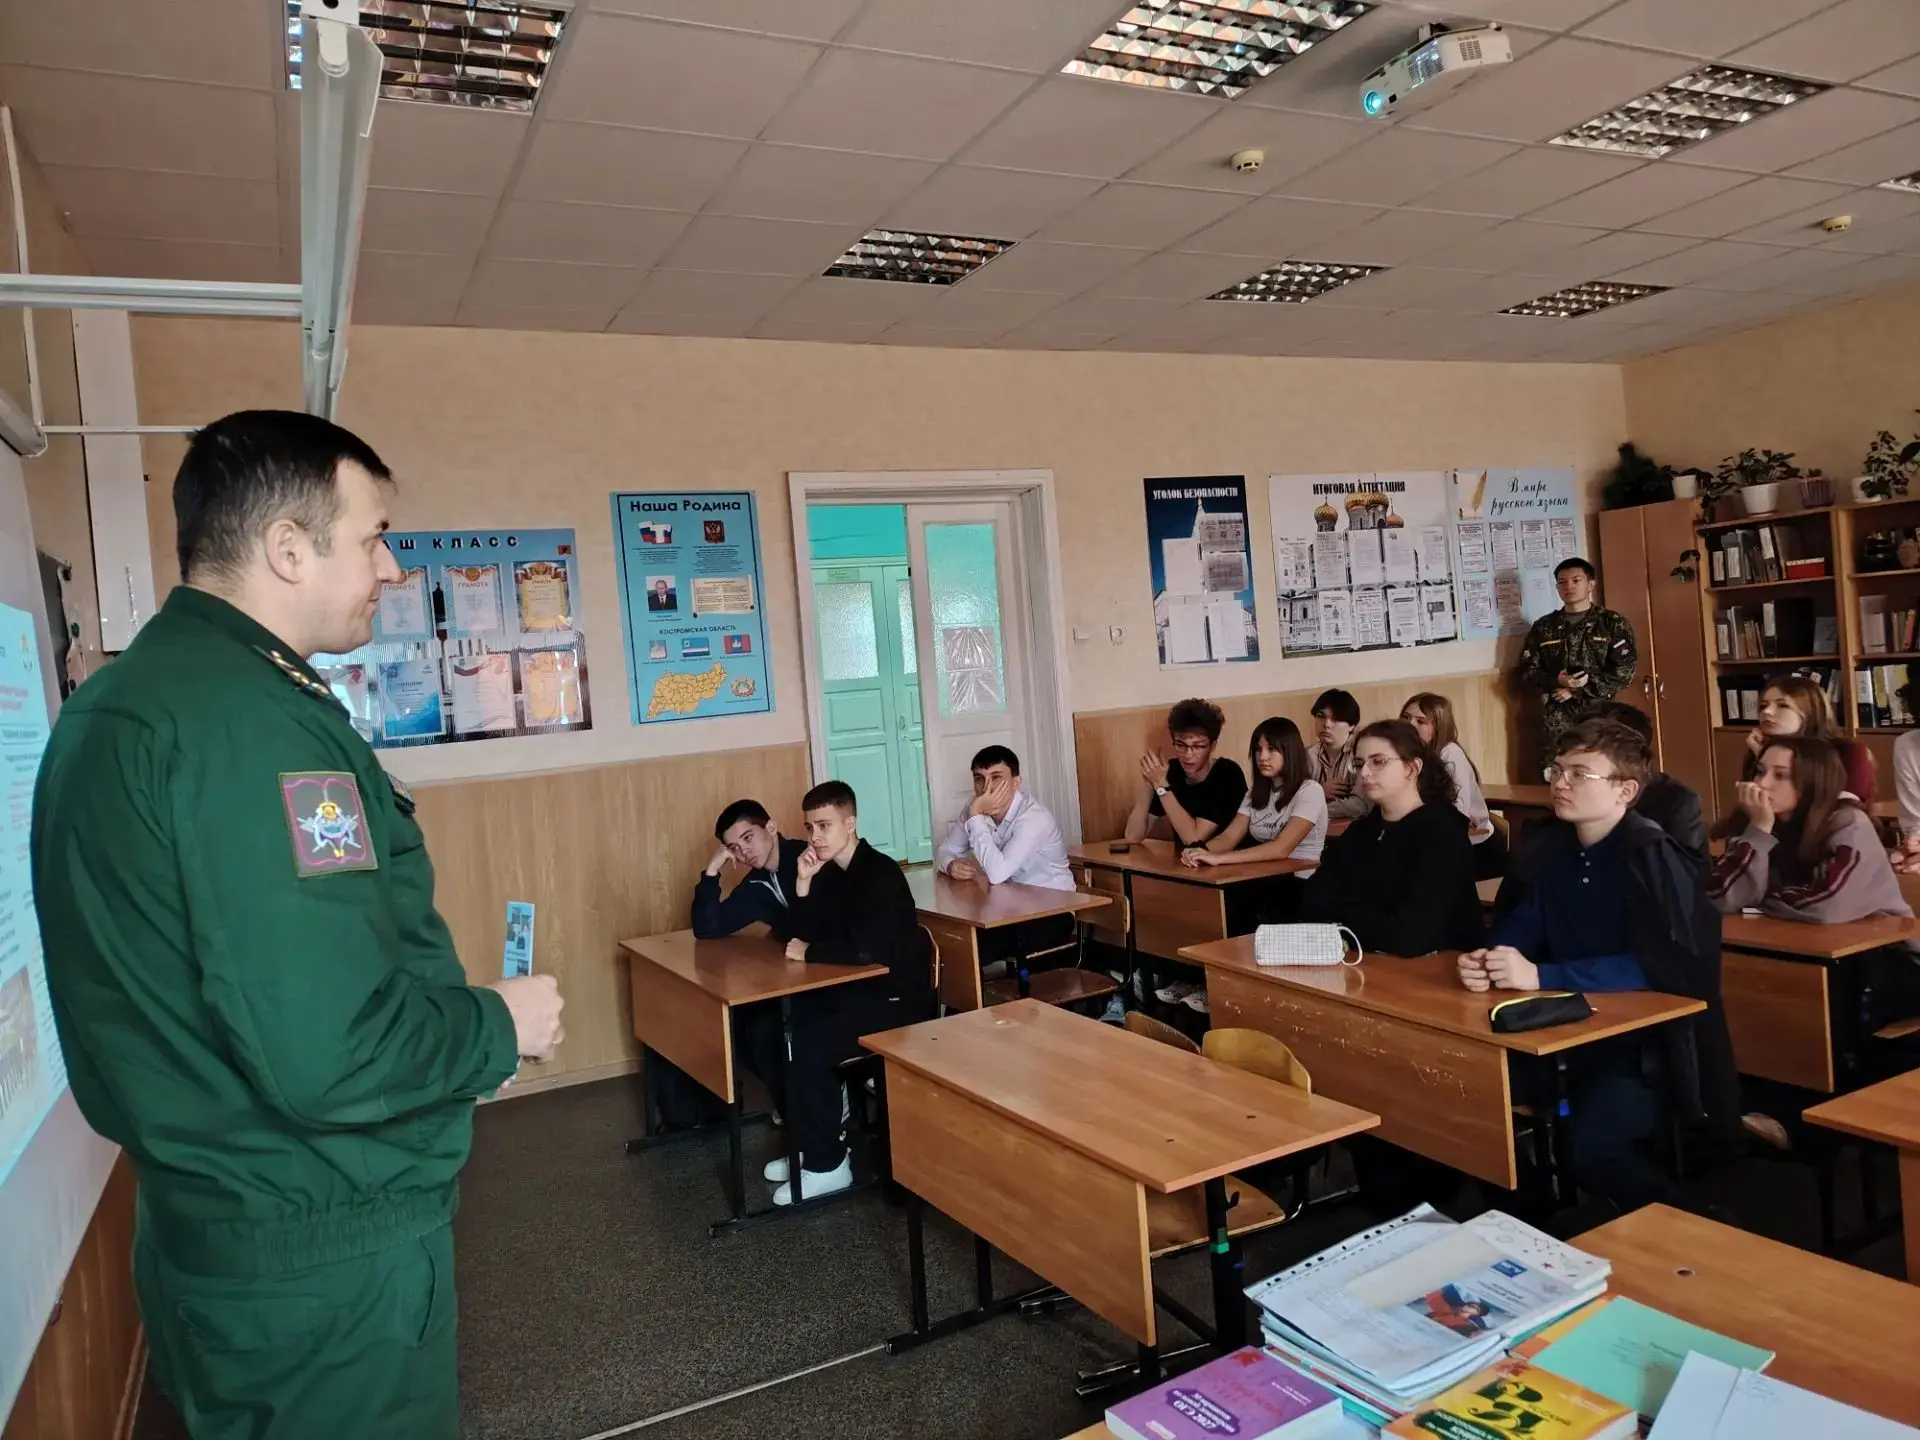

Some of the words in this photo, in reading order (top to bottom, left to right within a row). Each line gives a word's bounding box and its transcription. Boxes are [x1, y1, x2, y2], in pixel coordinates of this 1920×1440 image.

[1153, 489, 1182, 500] УГОЛОК
[1184, 487, 1238, 499] БЕЗОПАСНОСТИ
[1313, 483, 1356, 495] ИТОГОВАЯ
[1357, 481, 1405, 494] АТТЕСТАЦИЯ
[1508, 476, 1519, 493] В
[1521, 480, 1547, 498] мире
[630, 500, 678, 512] Наша
[683, 500, 741, 512] Родина
[1490, 498, 1535, 516] русского
[1536, 498, 1568, 512] языка
[433, 536, 519, 549] КЛАСС
[659, 626, 707, 635] КОСТРОМСКАЯ
[708, 624, 737, 632] ОБЛАСТЬ
